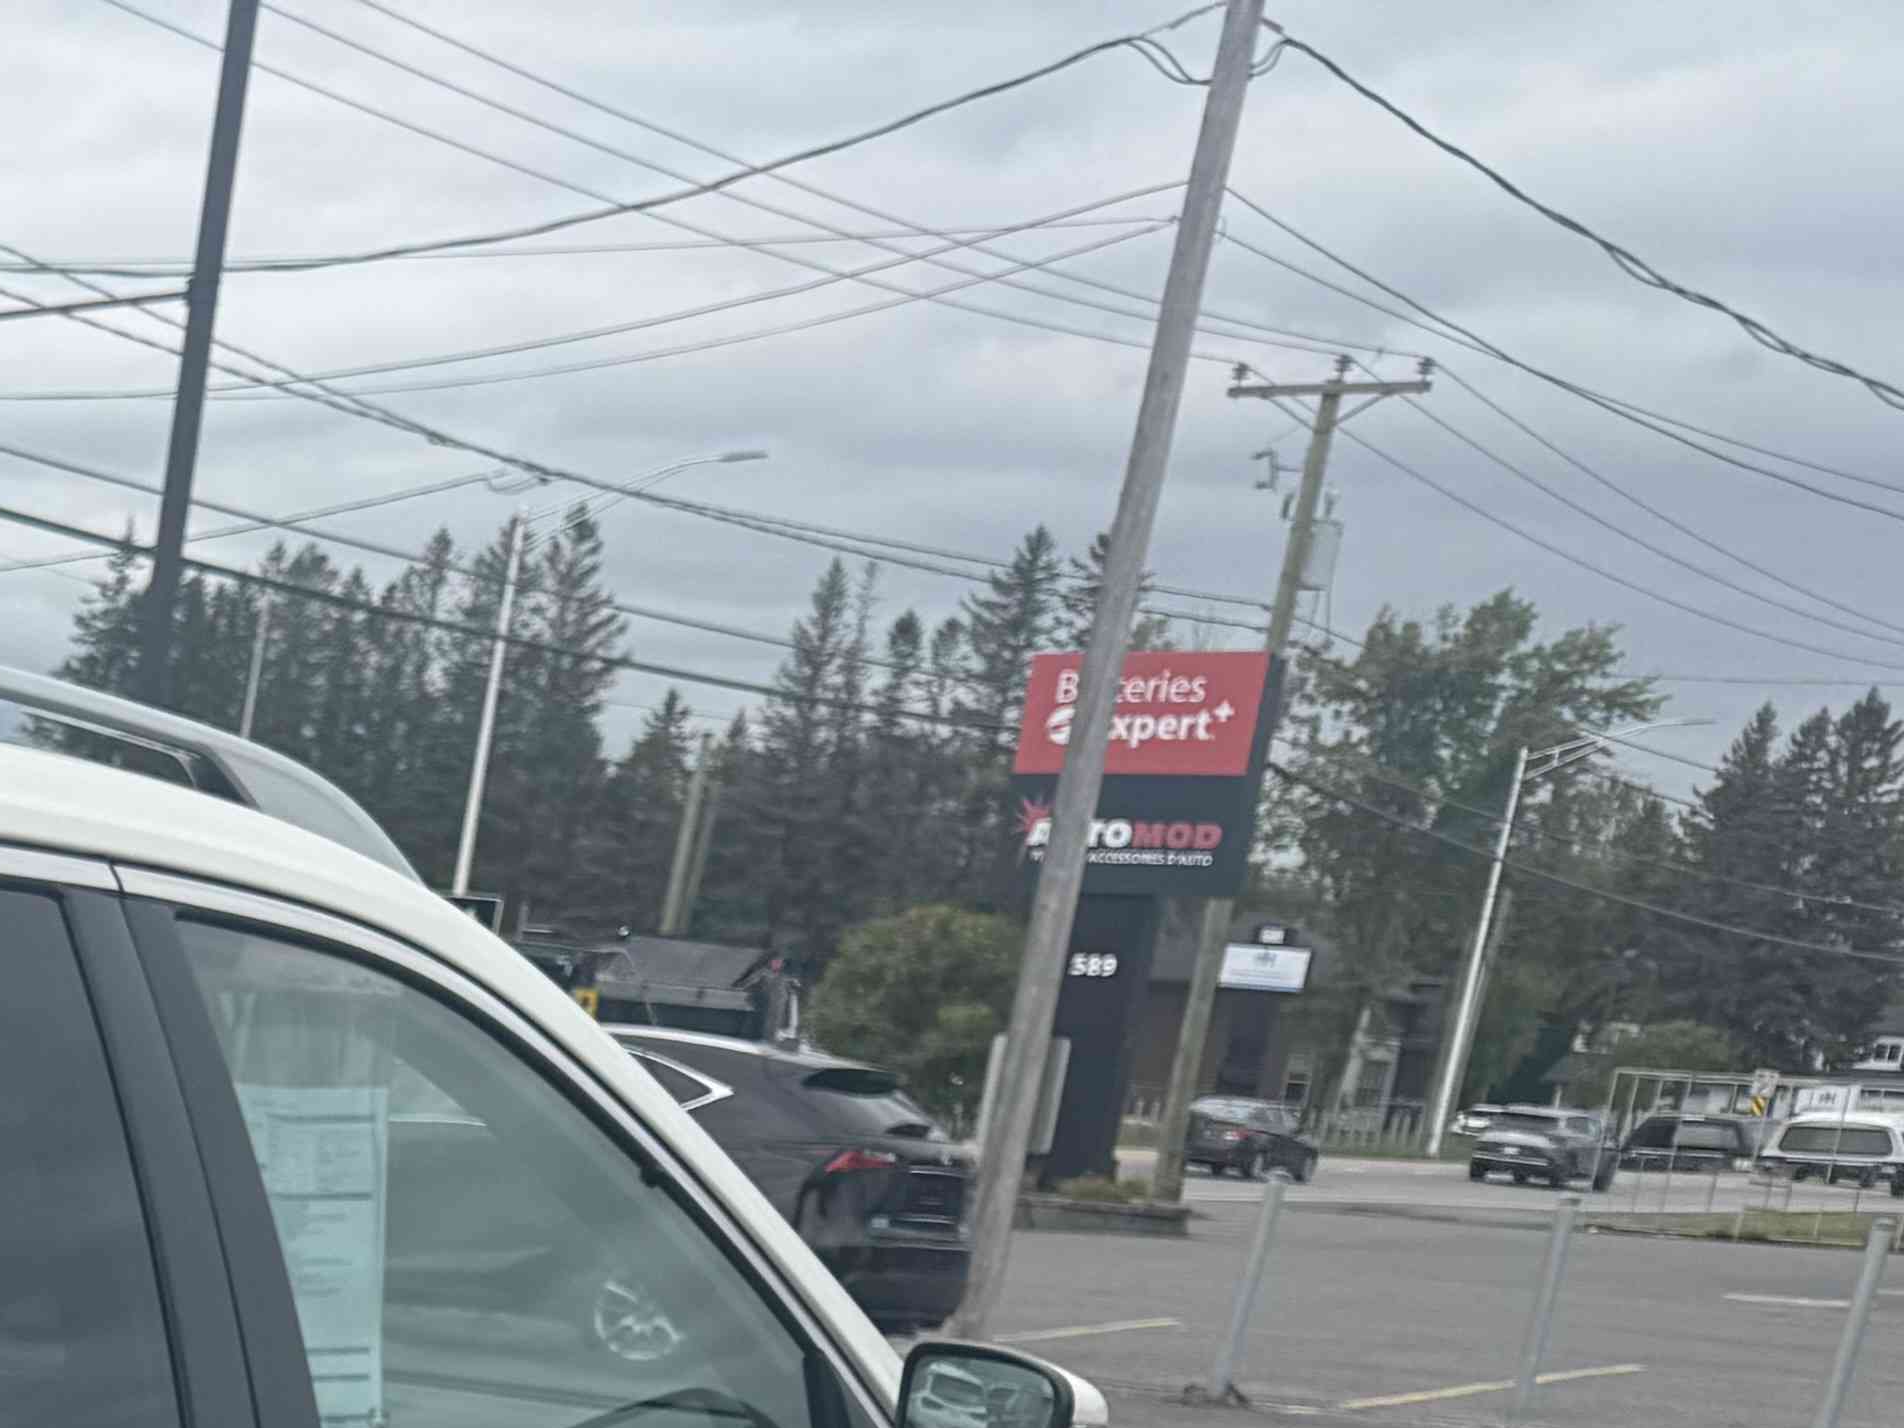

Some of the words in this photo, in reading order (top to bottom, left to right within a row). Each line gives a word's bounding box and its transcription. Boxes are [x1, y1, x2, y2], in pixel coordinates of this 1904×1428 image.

[1055, 668, 1208, 704] Beries
[1025, 816, 1224, 849] ATOMOD
[1069, 952, 1118, 978] 589
